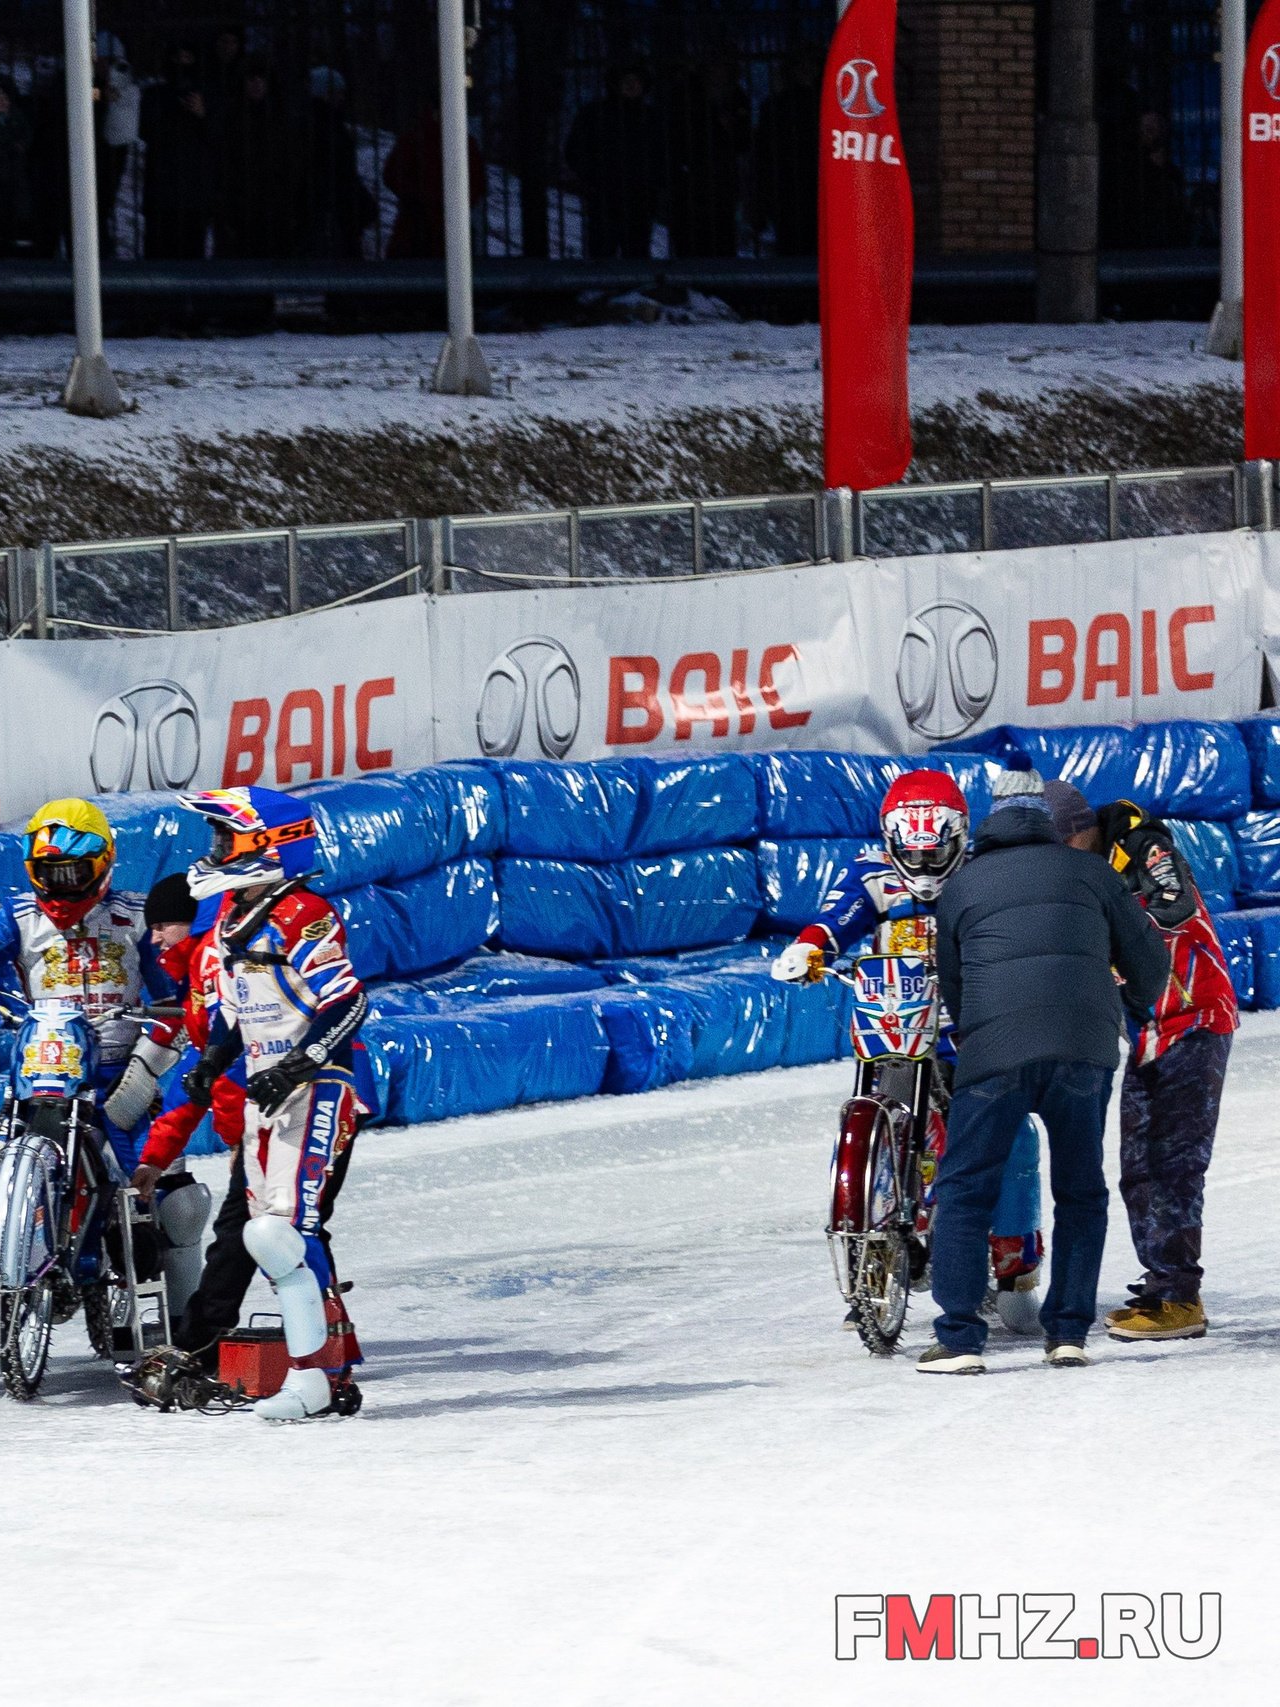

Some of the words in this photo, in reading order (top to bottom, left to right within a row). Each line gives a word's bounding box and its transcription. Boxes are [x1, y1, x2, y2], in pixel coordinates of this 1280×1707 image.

[605, 643, 813, 746] BAIC
[1028, 605, 1215, 706] BAIC
[222, 677, 395, 788] BAIC
[261, 1038, 293, 1056] LADA
[308, 1100, 336, 1157] LADA
